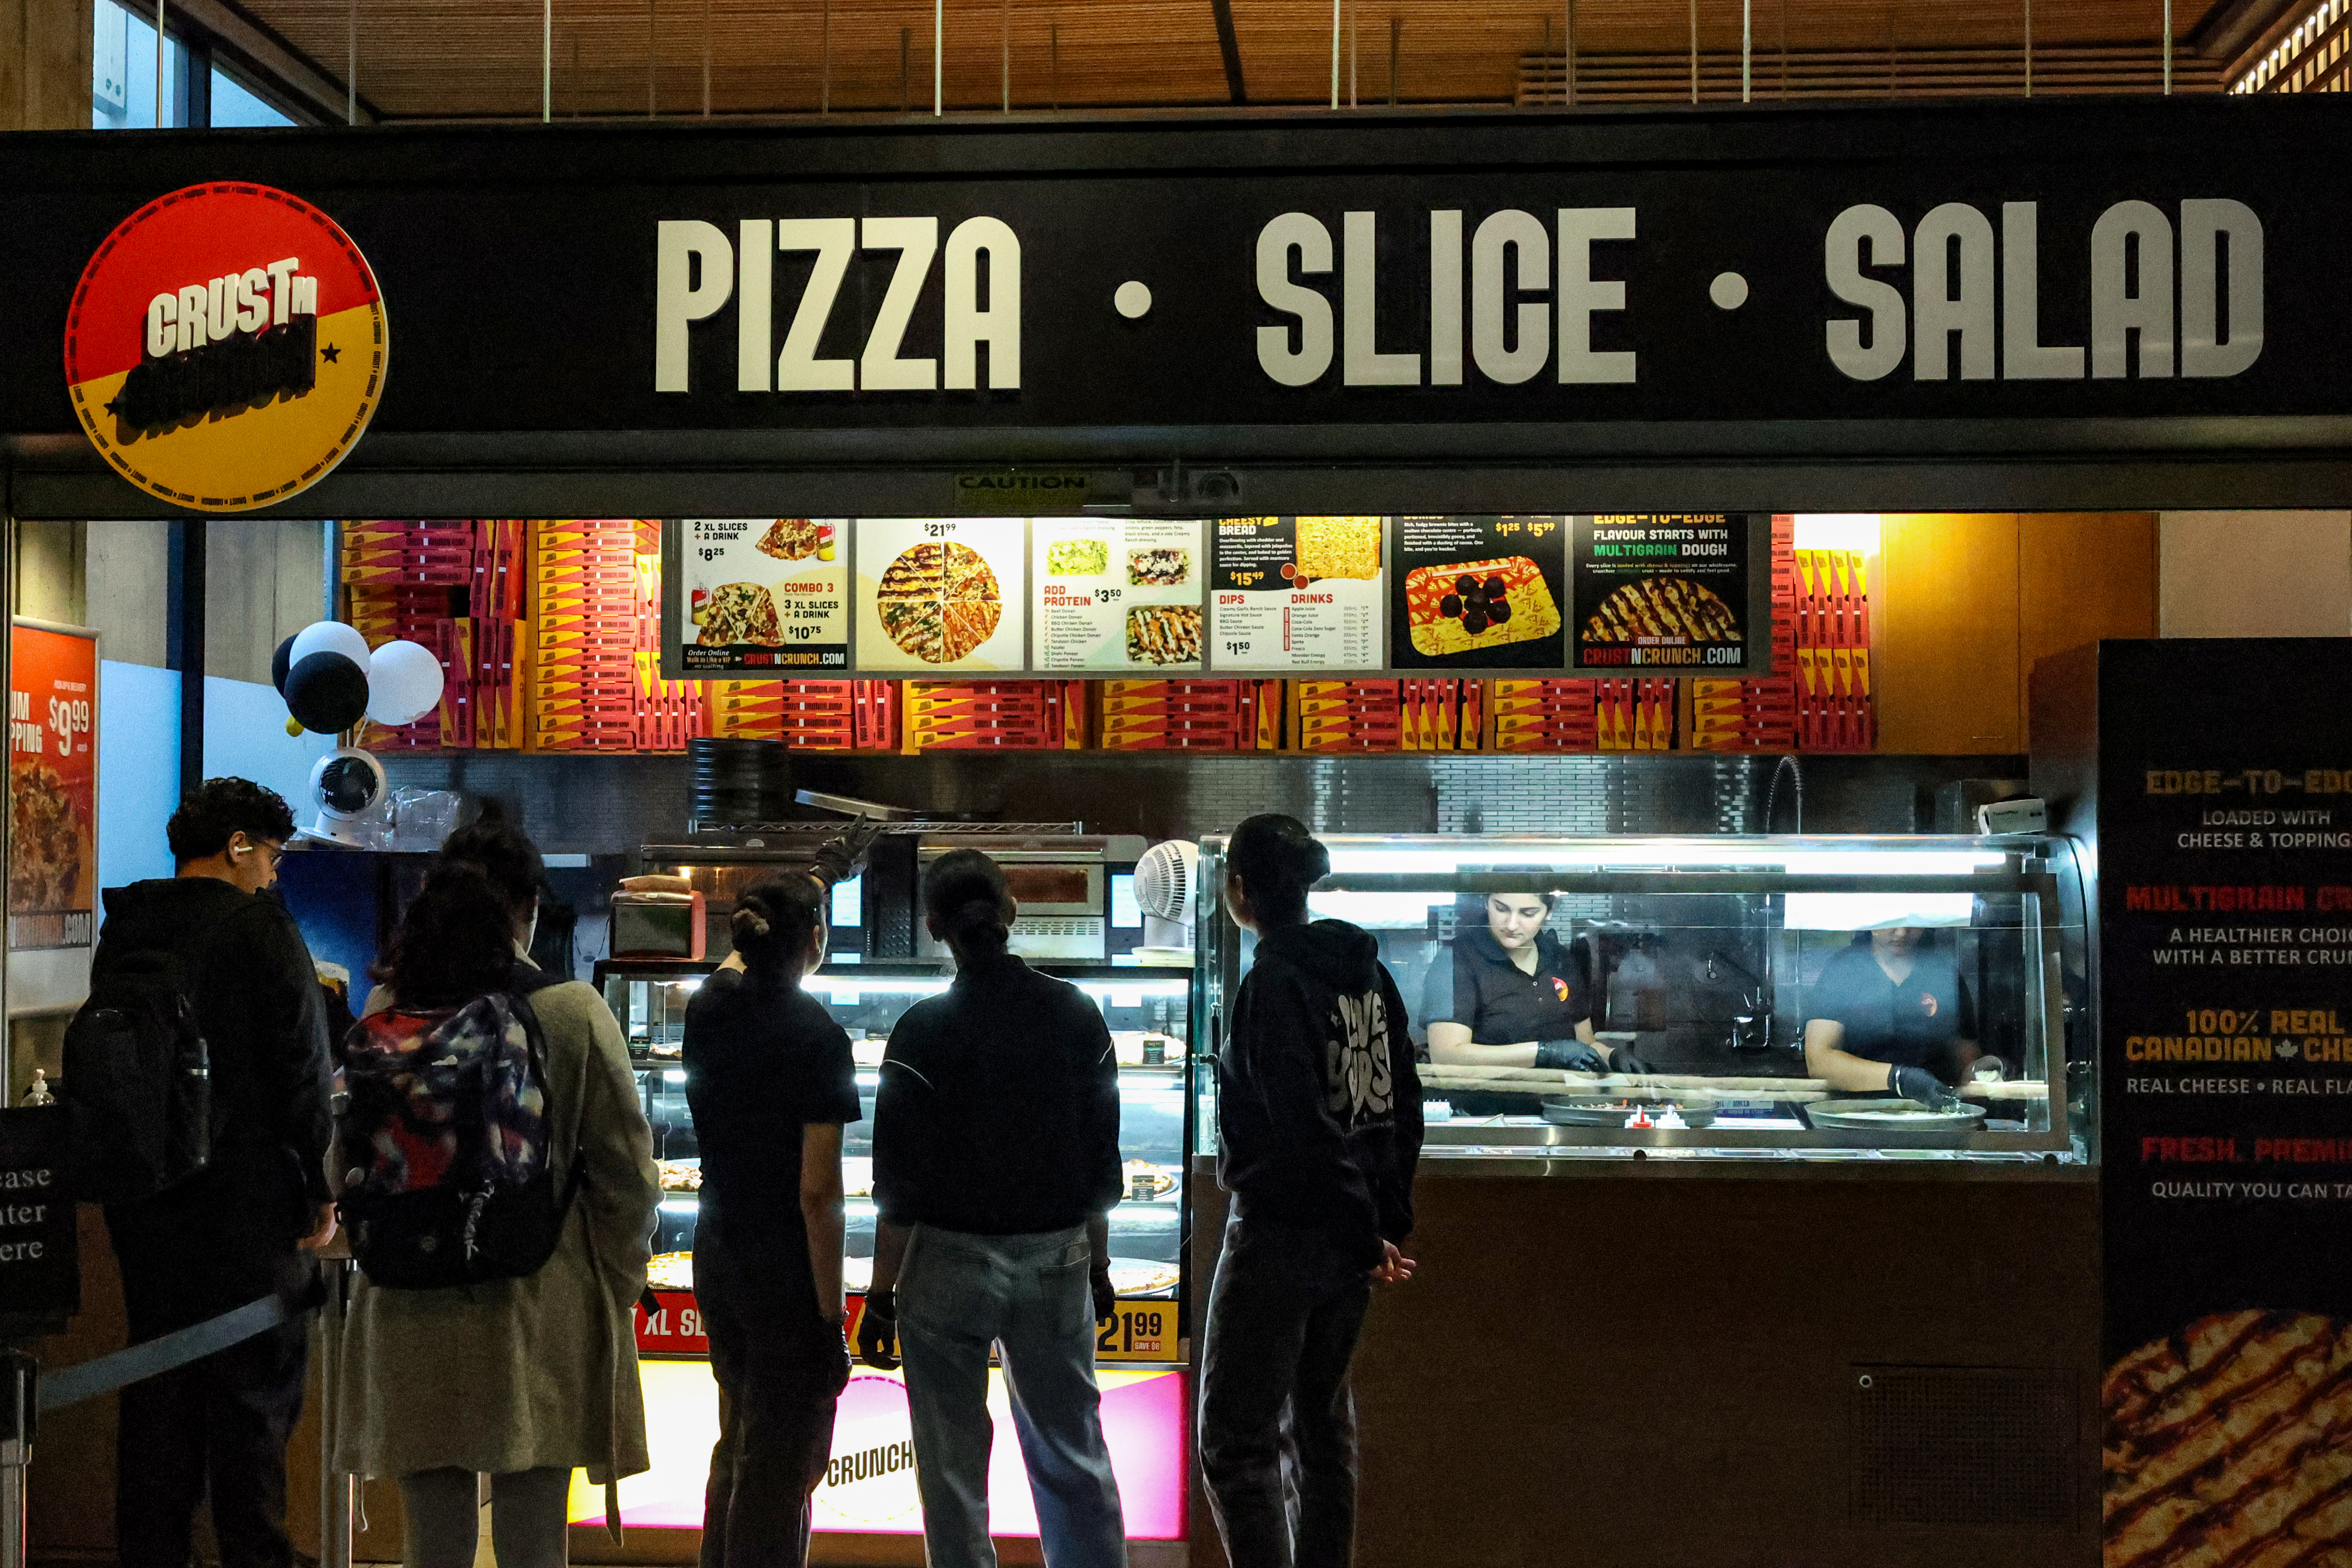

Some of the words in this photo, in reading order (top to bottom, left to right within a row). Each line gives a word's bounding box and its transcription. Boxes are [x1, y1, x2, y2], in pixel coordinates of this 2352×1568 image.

[655, 216, 1021, 393] PIZZA
[1256, 206, 1637, 387] SLICE
[1825, 198, 2264, 382] SALAD
[147, 257, 299, 358] CRUST
[959, 477, 1085, 490] CAUTION
[695, 522, 701, 530] 2
[1219, 517, 1262, 525] CHEESY
[1219, 525, 1256, 535] BREAD
[1593, 530, 1645, 540] FLAVOUR
[1649, 530, 1694, 540] STARTS
[1698, 529, 1728, 539] WITH
[1593, 544, 1677, 556] MULTIGRAIN
[1682, 544, 1727, 556] DOUGH
[785, 583, 823, 592] COMBO
[827, 583, 833, 592] 3
[1044, 586, 1066, 594] ADD
[784, 600, 791, 609] 3
[1044, 597, 1090, 606] PROTEIN
[1220, 595, 1244, 604] DIPS
[1292, 594, 1333, 603] DRINKS
[1638, 637, 1659, 645] ORDER
[1662, 636, 1686, 644] ONLINE
[744, 653, 844, 665] CRUSTNCRUNCH.COM
[1583, 647, 1740, 665] CRUSTNCRUNCH.COM
[2203, 811, 2275, 826] LOADED
[2282, 811, 2331, 825] WITH
[2178, 833, 2243, 848] CHEESE
[2249, 833, 2263, 848] &
[2125, 884, 2306, 912] MULTIGRAIN
[2170, 928, 2182, 942] A
[2189, 928, 2292, 943] HEALTHIER
[2153, 949, 2204, 964] WITH
[2211, 949, 2224, 964] A
[2230, 949, 2300, 964] BETTER
[2187, 1009, 2259, 1035] 100%
[2271, 1010, 2345, 1035] REAL
[2126, 1037, 2271, 1061] CANADIAN
[2127, 1078, 2174, 1093] REAL
[2179, 1078, 2250, 1093] CHEESE
[2272, 1079, 2319, 1093] REAL
[0, 1169, 50, 1188] ase
[2152, 1182, 2233, 1197] QUALITY
[2242, 1182, 2281, 1197] YOU
[2287, 1183, 2328, 1198] CAN
[644, 1309, 671, 1335] XL
[1152, 1342, 1160, 1350] $6
[827, 1439, 914, 1489] CRUNCH
